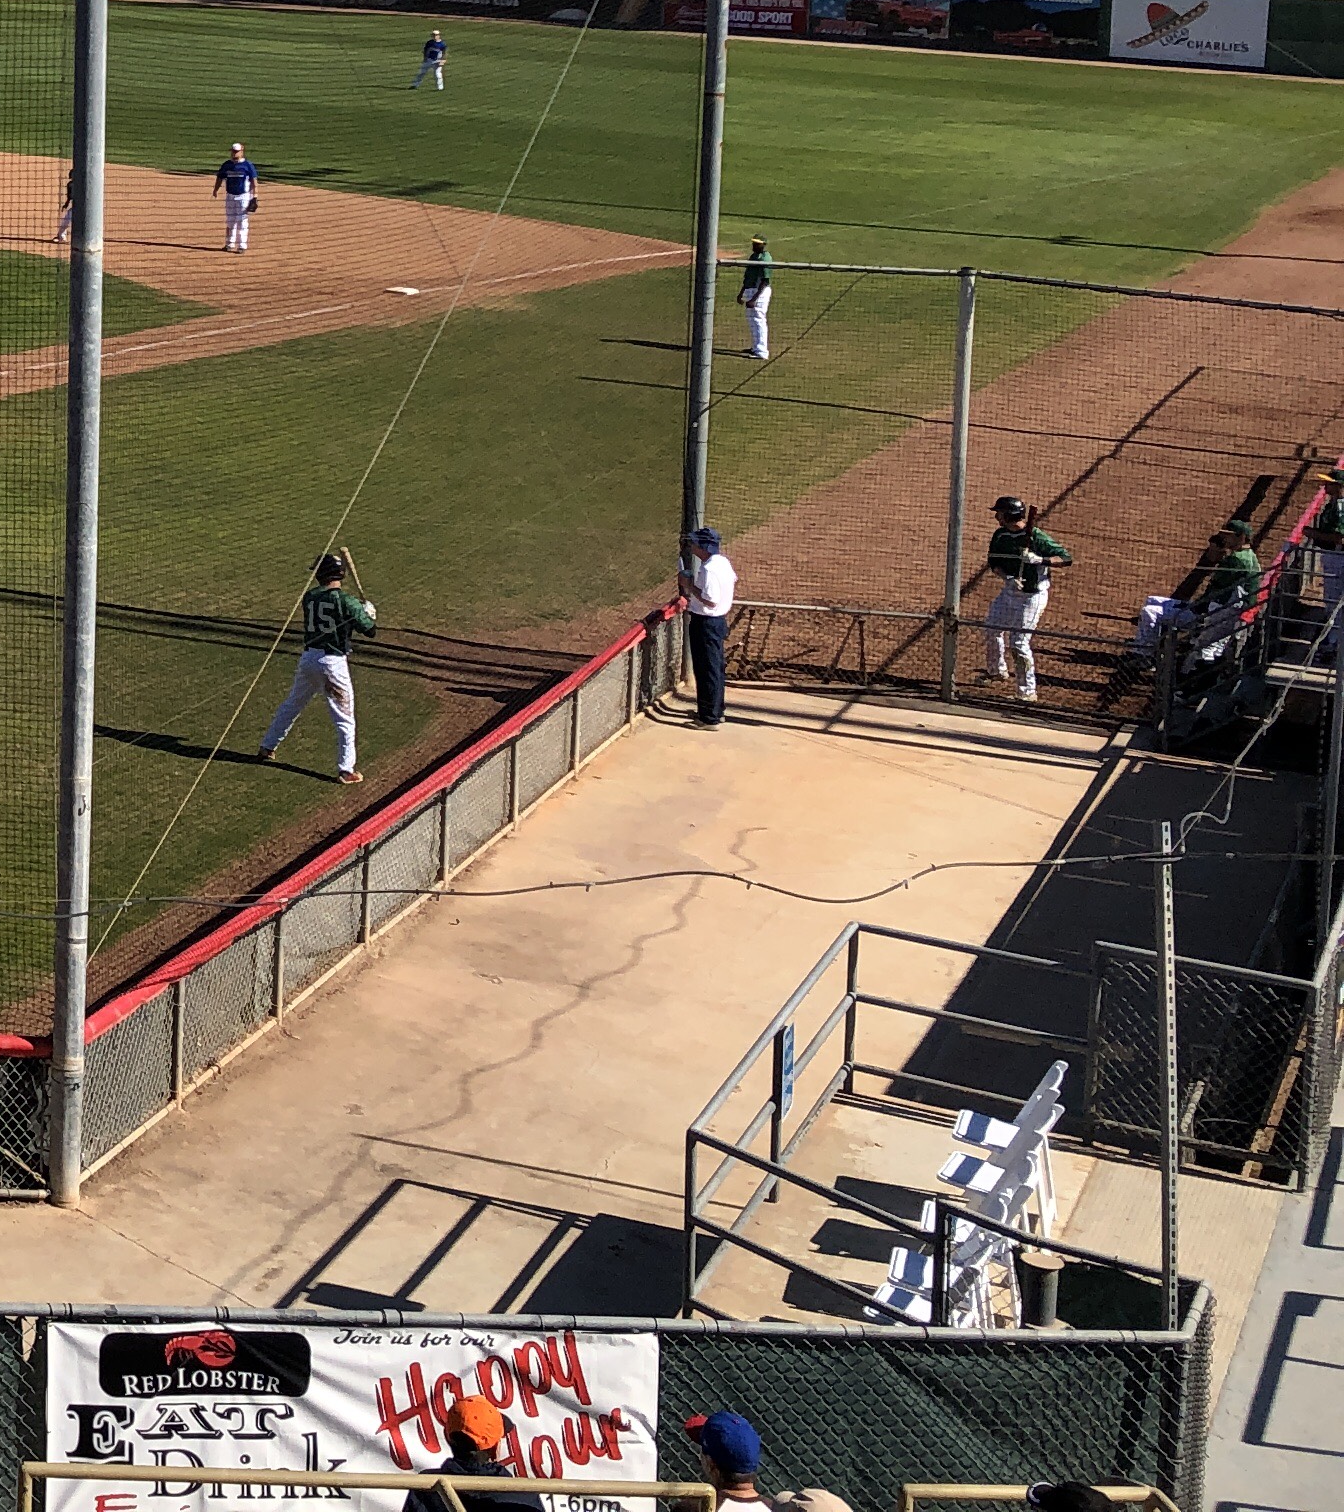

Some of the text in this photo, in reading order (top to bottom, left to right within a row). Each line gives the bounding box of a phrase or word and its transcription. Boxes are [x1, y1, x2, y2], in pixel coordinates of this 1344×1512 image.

[758, 12, 794, 24] SPORT
[1160, 28, 1190, 47] LOCO
[306, 600, 336, 634] 15
[333, 1328, 496, 1348] Join us for our
[122, 1366, 280, 1396] RED LOBSTER
[65, 1402, 295, 1466] EAT
